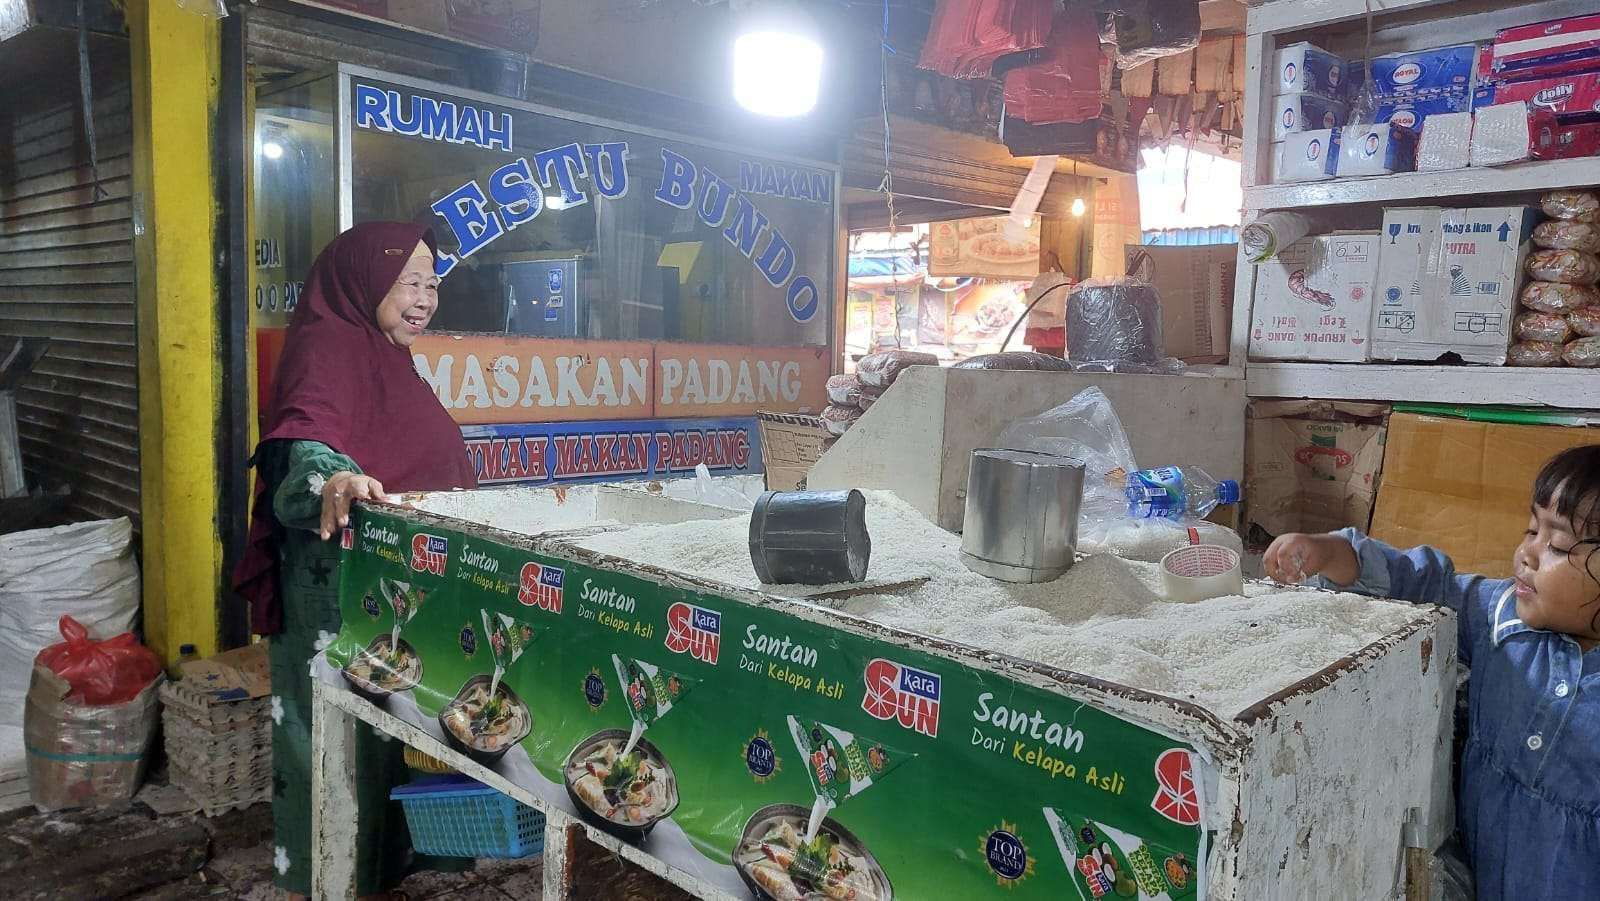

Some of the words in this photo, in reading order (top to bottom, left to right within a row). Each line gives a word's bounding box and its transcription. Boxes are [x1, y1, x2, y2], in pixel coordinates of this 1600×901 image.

[1394, 68, 1419, 78] ROYAL
[1540, 84, 1574, 101] Jolly
[356, 85, 512, 152] RUMAH
[740, 160, 832, 205] MAKAN
[431, 142, 629, 277] ESTU
[655, 147, 820, 324] BUNDO
[1445, 242, 1476, 255] UTRA
[1303, 333, 1346, 343] KRUPUK
[414, 354, 649, 409] MASAKAN
[660, 358, 801, 405] PADANG
[552, 432, 652, 479] MAKAN
[654, 427, 750, 474] PADANG
[362, 521, 400, 546] Santan
[430, 538, 445, 551] kara
[411, 533, 447, 578] SUN
[459, 544, 499, 574] Santan
[457, 566, 472, 581] Dari
[472, 571, 494, 590] Kelapa
[495, 580, 510, 595] Asli
[518, 562, 564, 615] SUN
[543, 567, 561, 585] kara
[580, 578, 636, 615] Santan
[578, 603, 597, 621] Dari
[597, 609, 630, 633] Kelapa
[633, 621, 654, 640] Asli
[664, 602, 721, 666] SUN
[694, 609, 717, 630] kara
[742, 624, 819, 669] Santan
[739, 653, 764, 675] Dari
[768, 661, 812, 691] Kelapa
[816, 677, 845, 701] Asli
[903, 667, 937, 696] kara
[861, 658, 941, 739] SUN
[973, 692, 1085, 754] Santan
[752, 742, 771, 761] TOP
[971, 727, 1006, 754] Dari
[1012, 740, 1076, 779] Kelapa
[1085, 767, 1126, 796] Asli
[990, 850, 1022, 870] BRAND
[991, 836, 1022, 860] TOP
